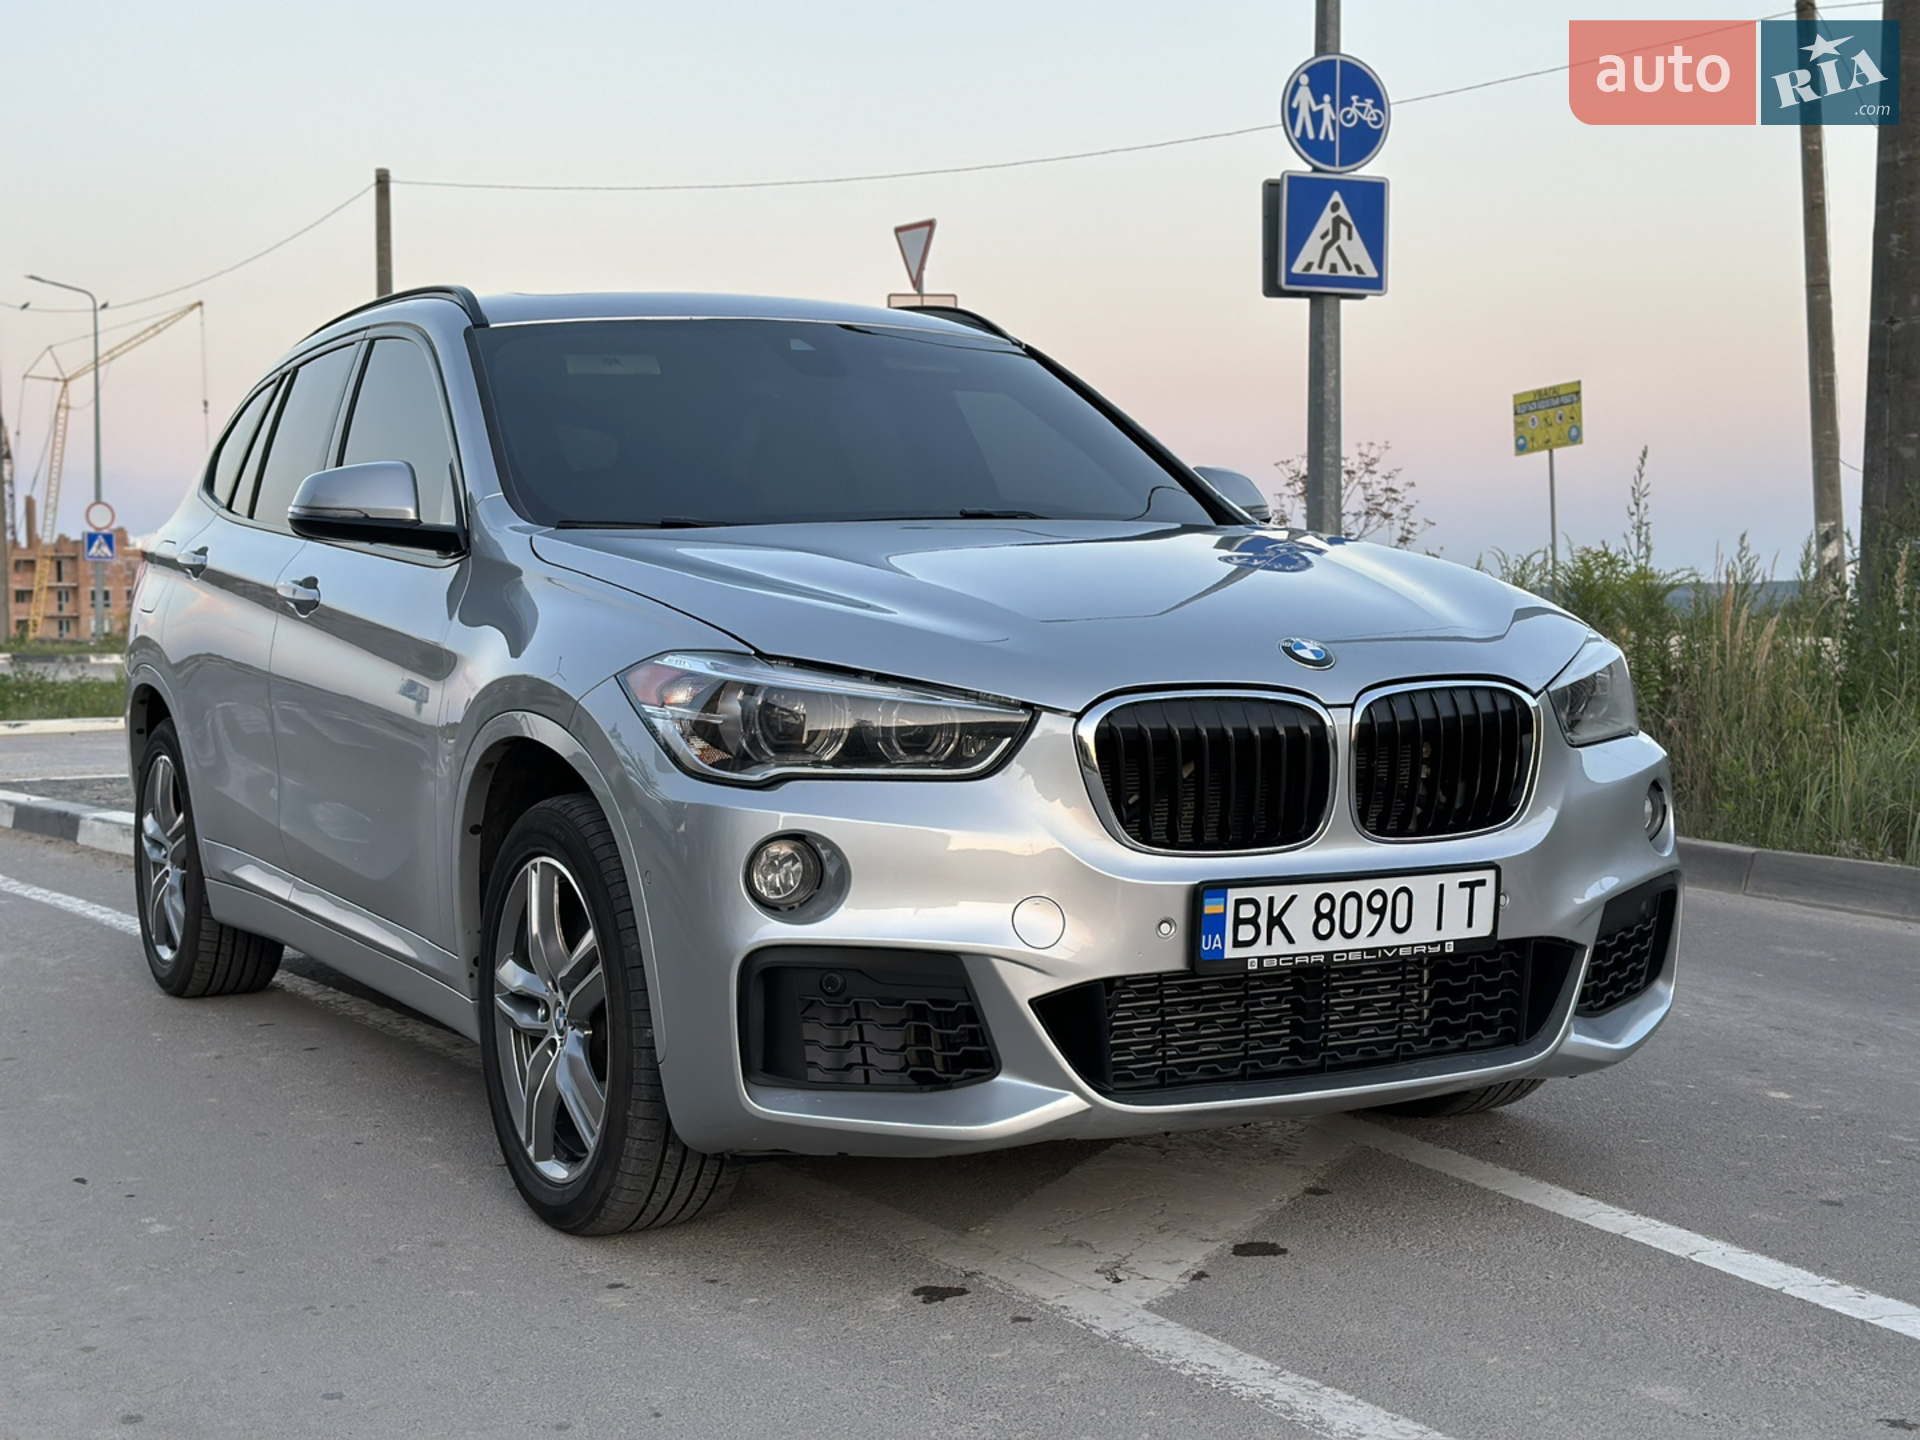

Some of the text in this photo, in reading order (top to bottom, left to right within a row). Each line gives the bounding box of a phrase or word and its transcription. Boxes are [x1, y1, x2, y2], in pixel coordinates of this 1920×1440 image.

[1232, 879, 1487, 949] BK 8090 IT
[1202, 934, 1223, 950] UA
[1263, 944, 1441, 968] BCAR DELIVERY
